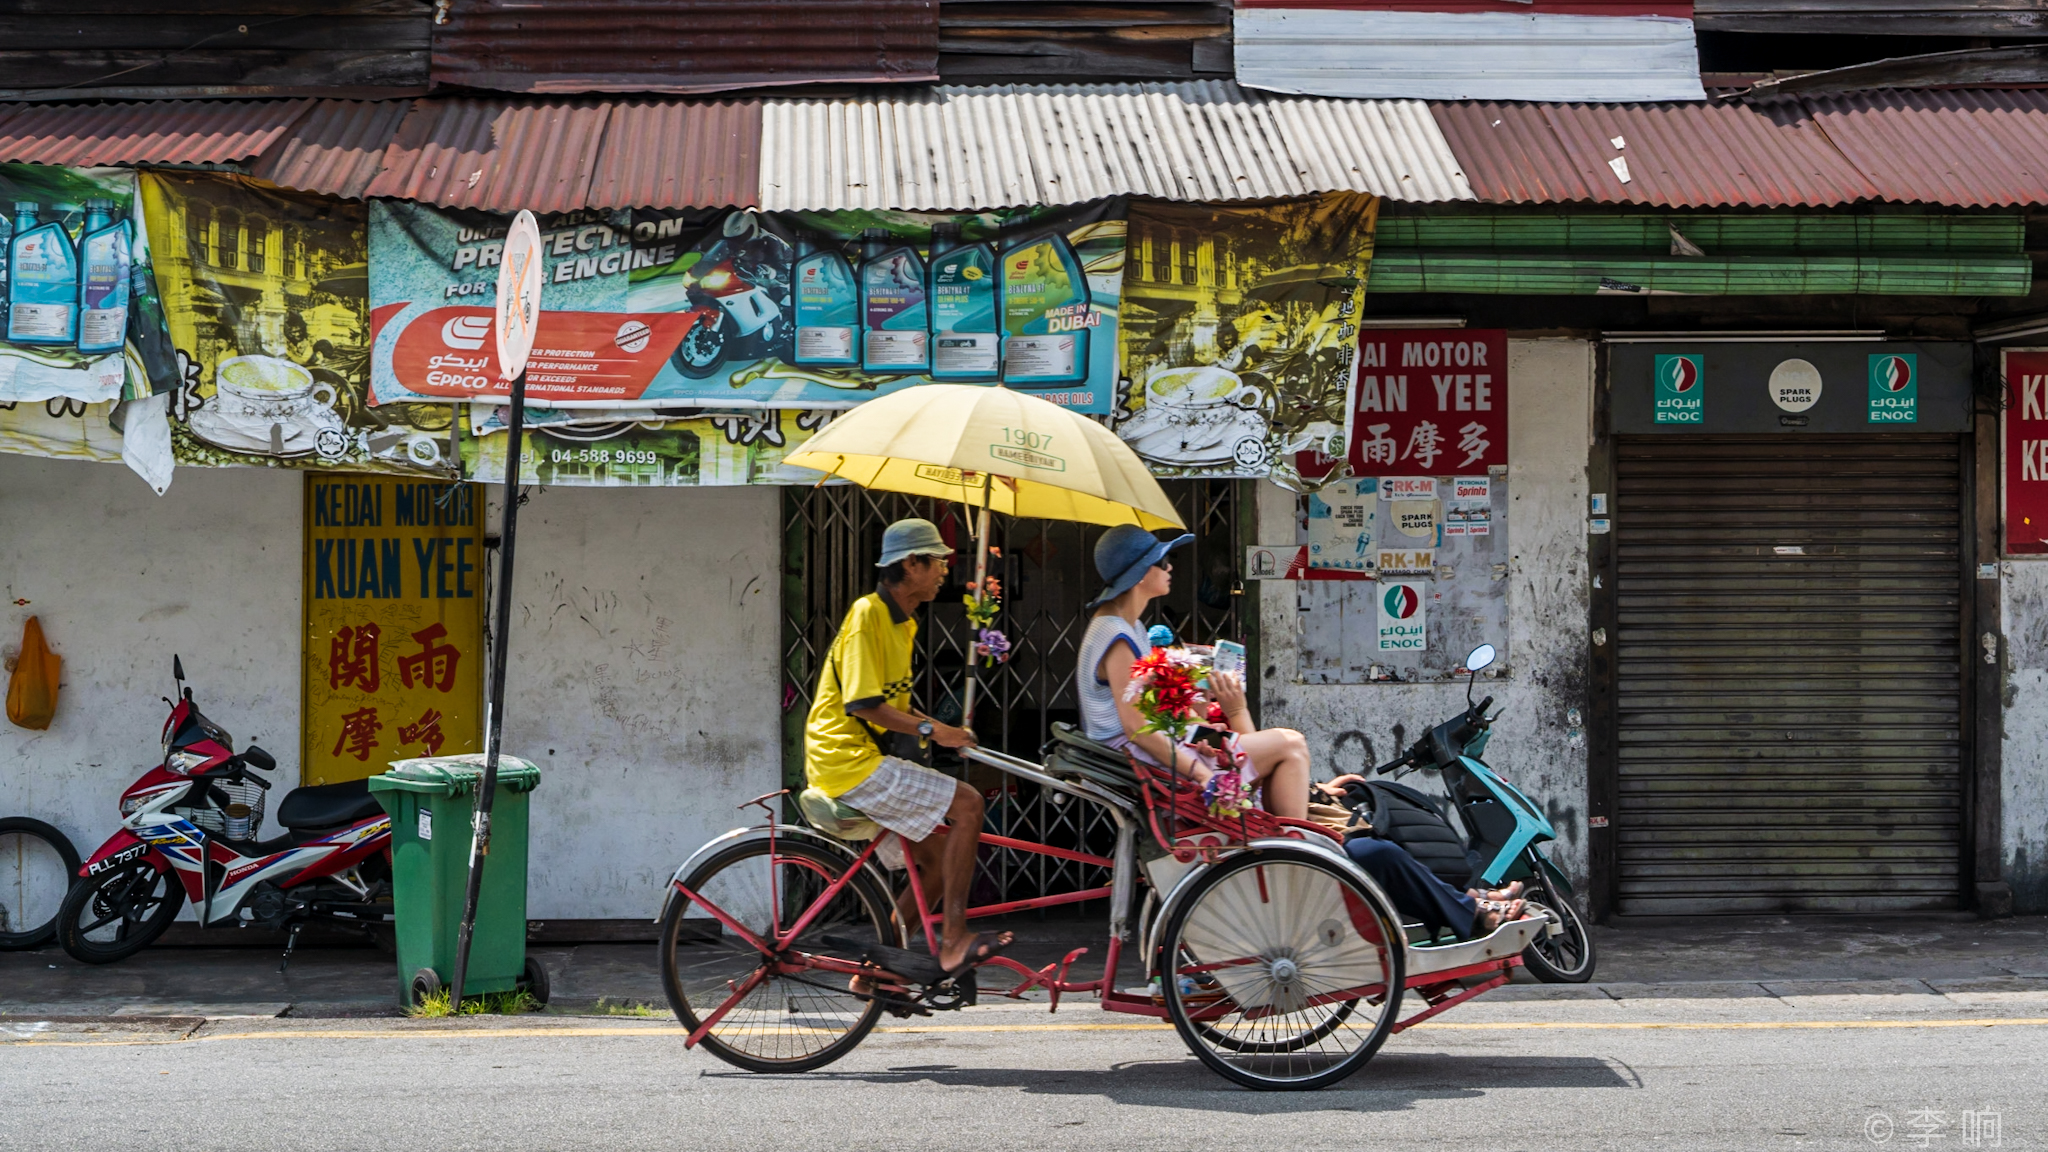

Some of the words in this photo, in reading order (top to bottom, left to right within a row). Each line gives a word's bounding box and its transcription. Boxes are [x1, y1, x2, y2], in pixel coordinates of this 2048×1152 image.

[453, 217, 684, 270] PRTECTION
[446, 280, 487, 297] FOR
[554, 244, 677, 283] ENGINE
[1045, 305, 1075, 319] MADE
[1076, 304, 1087, 314] IN
[1048, 311, 1101, 333] DUBAI
[544, 350, 595, 358] PROTECTION
[1402, 341, 1487, 367] MOTOR
[537, 363, 599, 371] PERFORMANCE
[426, 371, 488, 388] EPPCO
[542, 375, 576, 383] EXCEEDS
[494, 382, 509, 390] ALL
[525, 384, 575, 393] ERNATIONAL
[577, 386, 626, 394] STANDARDS
[1431, 374, 1492, 411] YEE
[1071, 392, 1094, 404] OILS
[1657, 412, 1700, 421] ENOC
[1871, 411, 1914, 420] ENOC
[1002, 426, 1053, 450] 1907
[551, 449, 609, 464] 04-588
[615, 450, 657, 465] 9699
[1394, 480, 1434, 492] RK-M
[1457, 486, 1487, 497] Sprinta
[315, 484, 381, 527] KEDAI
[395, 484, 474, 527] MOTOR
[1380, 553, 1431, 568] RK-M
[315, 538, 402, 599] KUAN
[412, 538, 474, 598] YEE
[1380, 640, 1422, 648] ENOC
[89, 859, 115, 875] PLL
[115, 844, 148, 865] 7377
[229, 862, 259, 877] HONDA
